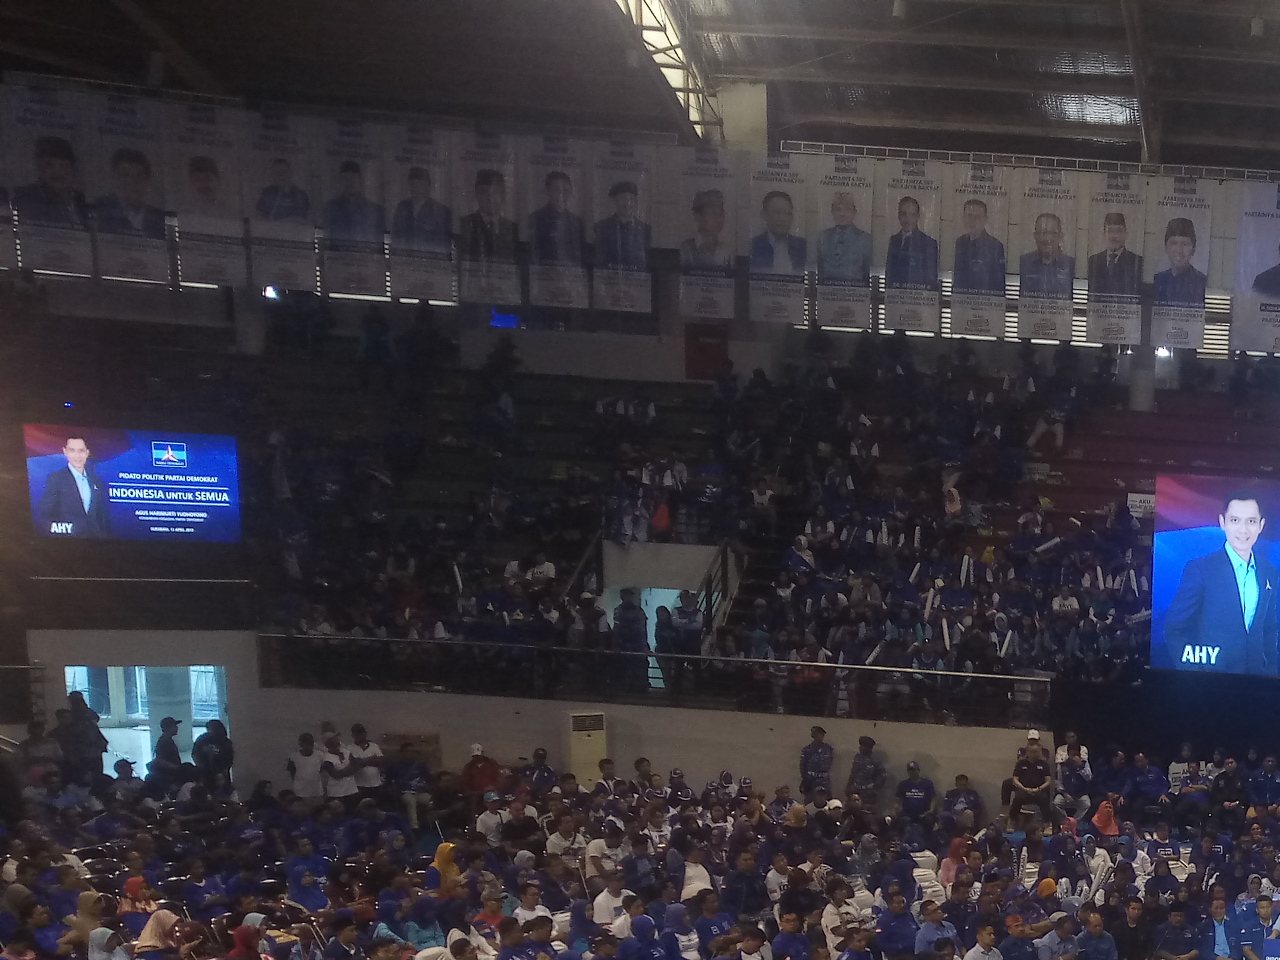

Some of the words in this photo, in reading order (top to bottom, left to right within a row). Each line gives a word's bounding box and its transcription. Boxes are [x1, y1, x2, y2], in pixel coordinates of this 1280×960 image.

[119, 472, 141, 480] PIDATO
[141, 473, 164, 481] POLITIK
[165, 474, 186, 482] PARTAI
[186, 475, 218, 483] DEMOKRAT
[109, 487, 165, 500] INDONESIA
[165, 491, 194, 501] UNTUK
[195, 491, 230, 502] SEMUA
[50, 522, 74, 534] AHY
[1181, 643, 1221, 665] AHY
